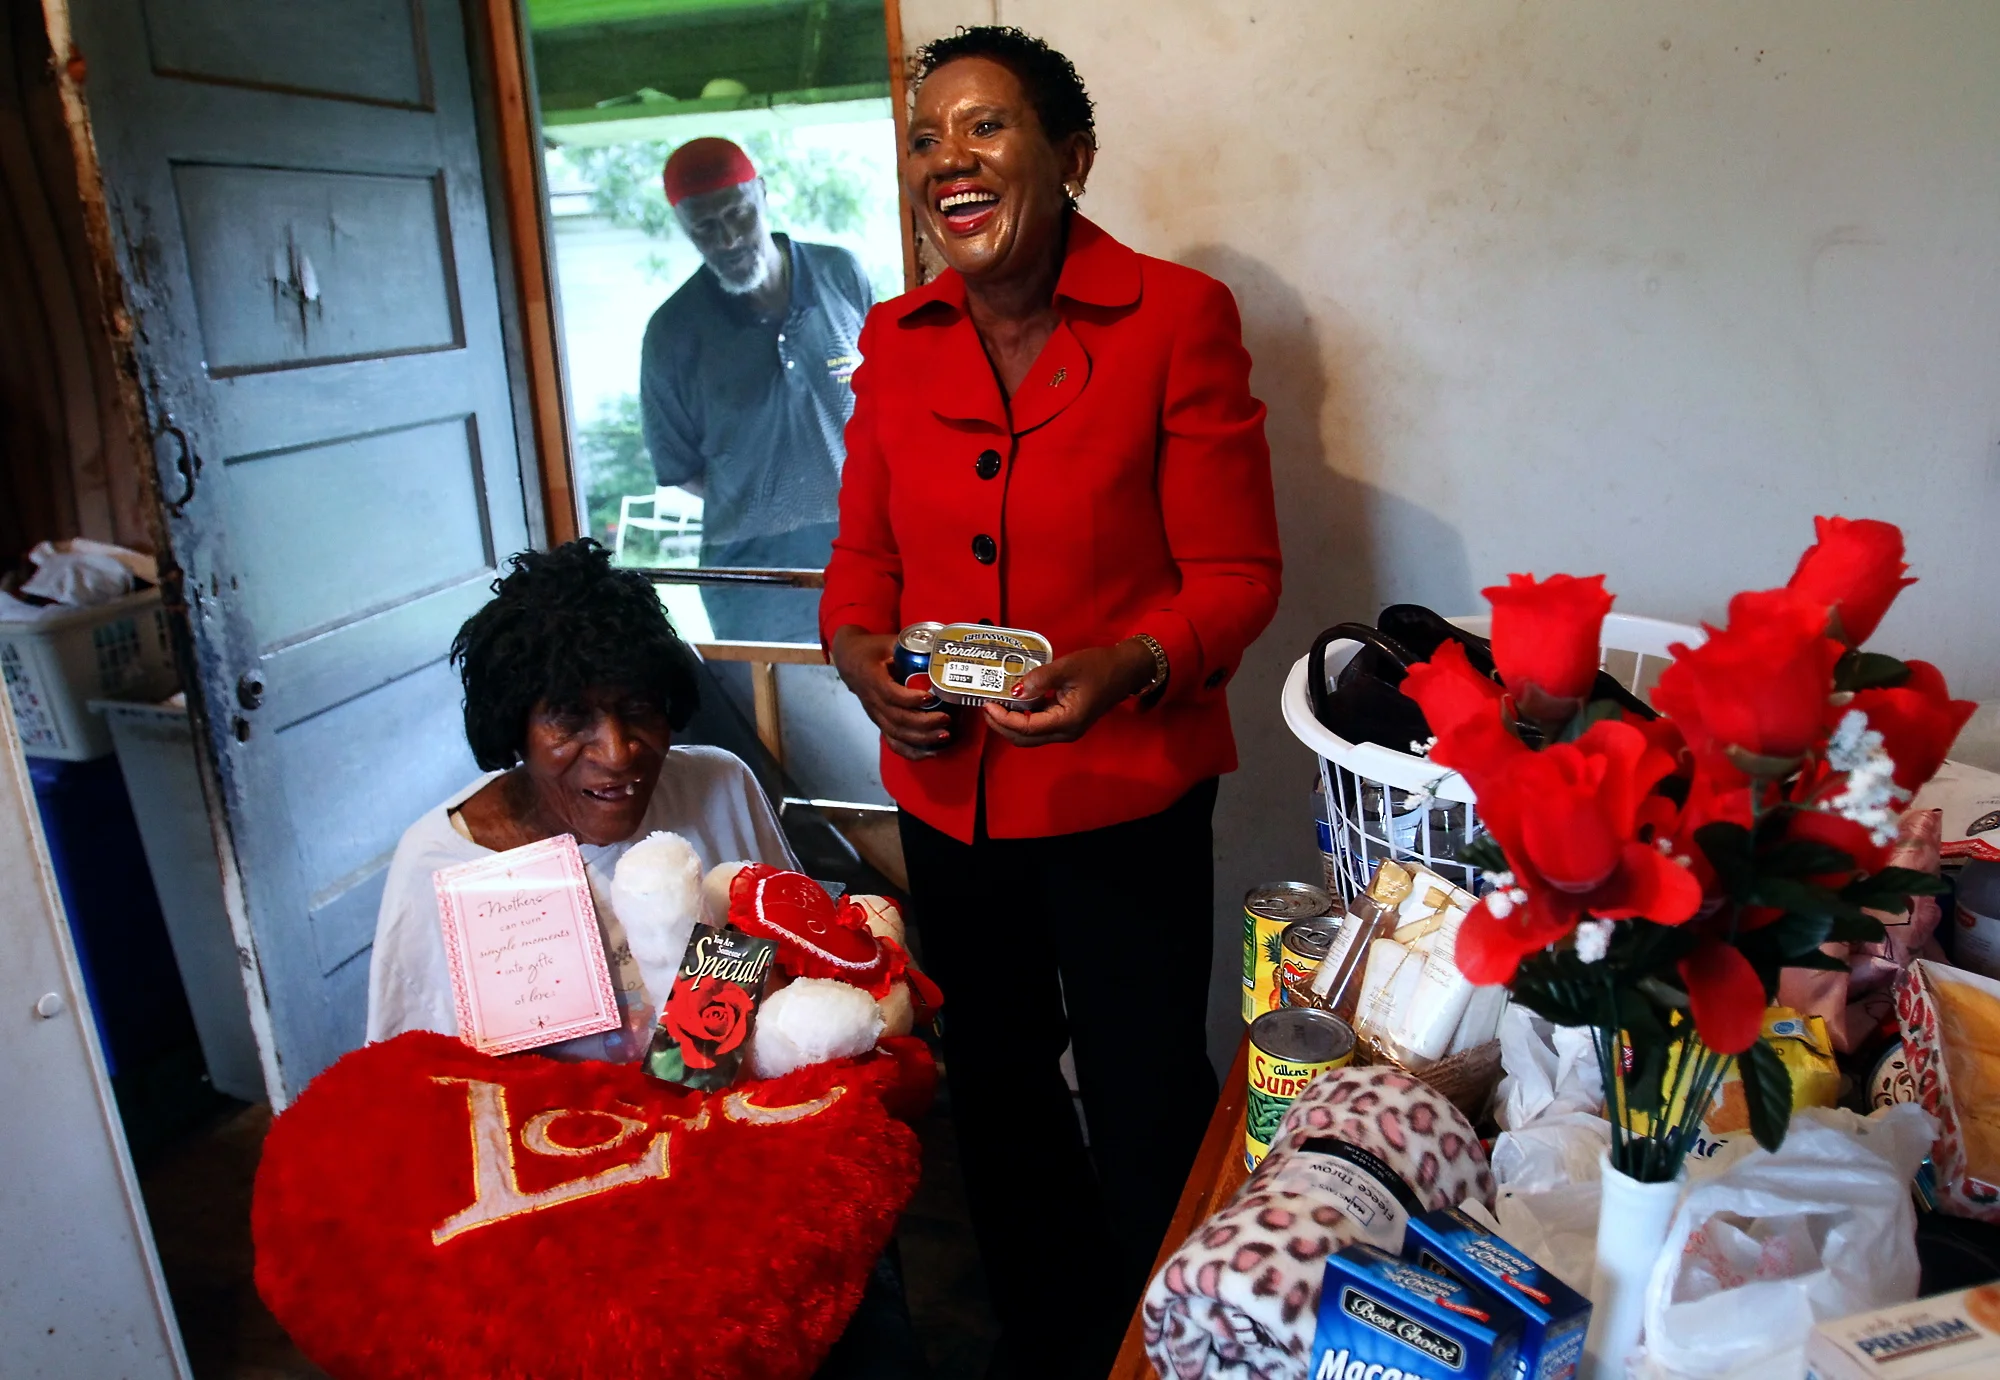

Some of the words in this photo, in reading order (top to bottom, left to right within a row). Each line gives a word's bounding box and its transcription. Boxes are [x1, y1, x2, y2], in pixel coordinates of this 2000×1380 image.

[939, 642, 998, 660] Sardines
[963, 632, 1023, 649] BRUNSWICK
[949, 663, 970, 672] $1.39
[478, 889, 561, 917] Mothers
[500, 923, 517, 932] can
[521, 917, 541, 926] turn
[713, 934, 724, 945] You
[724, 938, 735, 948] Are
[717, 945, 741, 959] Someone
[685, 936, 771, 991] Special!
[428, 1076, 848, 1247] Lo
[1309, 1164, 1354, 1187] Throw
[1319, 1183, 1366, 1216] MAINSTAYS
[1358, 1184, 1395, 1222] Fleece
[1473, 1240, 1535, 1272] Macaroni
[1476, 1249, 1520, 1276] Cheese
[1350, 1298, 1396, 1329] Best
[1396, 1320, 1457, 1361] Choice
[1856, 1318, 1975, 1358] PREMIUM
